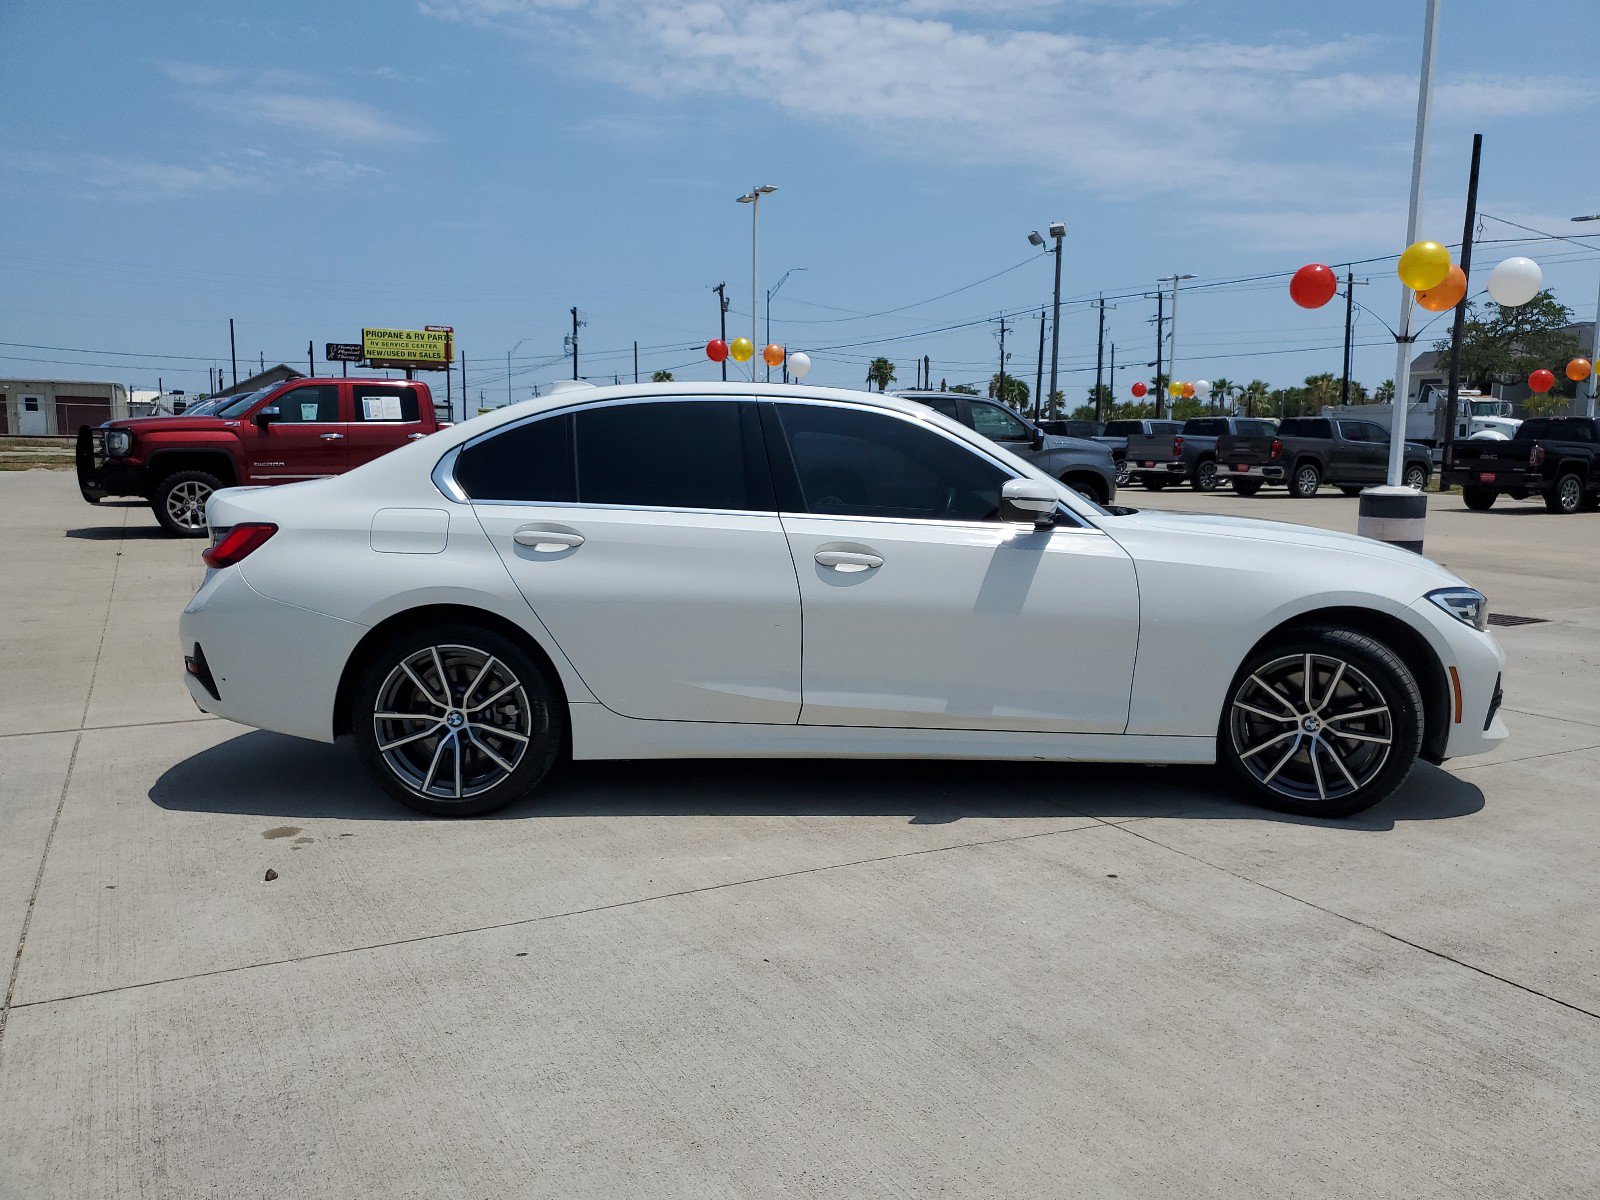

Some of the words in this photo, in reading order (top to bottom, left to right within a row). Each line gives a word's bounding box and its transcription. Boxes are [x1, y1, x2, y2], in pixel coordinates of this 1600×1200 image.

[365, 330, 405, 340] PROPANE
[406, 332, 412, 340] &
[414, 333, 425, 341] RV
[427, 334, 453, 342] PARTS
[366, 349, 406, 358] NEW/USED
[418, 351, 441, 359] SALES
